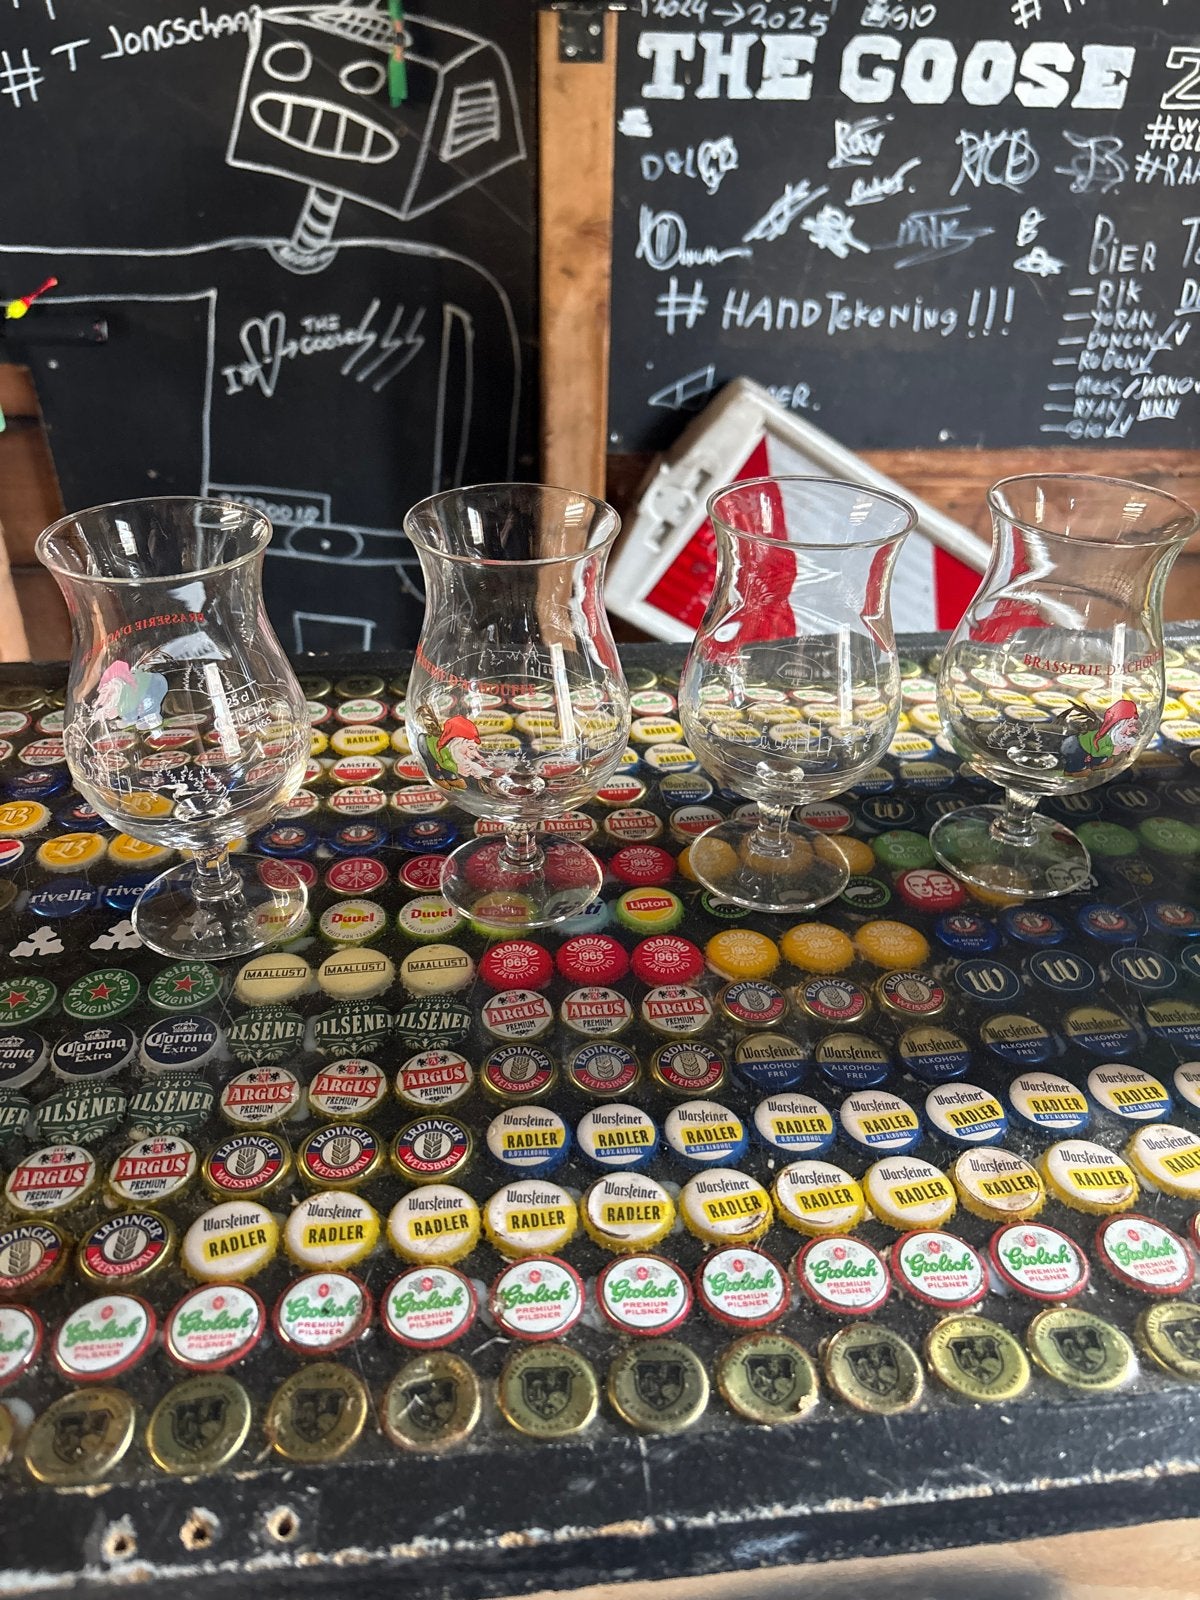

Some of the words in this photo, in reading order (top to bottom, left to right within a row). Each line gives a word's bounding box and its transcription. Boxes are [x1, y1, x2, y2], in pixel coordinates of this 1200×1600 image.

[637, 31, 818, 101] THE
[839, 34, 1136, 109] GOOSE
[1023, 652, 1102, 677] BRASSERIE
[346, 735, 380, 745] RADLER
[336, 794, 382, 805] ARGUS
[608, 818, 656, 829] ARGUS
[630, 858, 653, 868] 1965
[30, 889, 92, 904] rivella
[629, 899, 670, 910] Lipton
[331, 912, 375, 924] Duvel
[410, 907, 453, 919] Duvel
[503, 957, 529, 969] 1965
[155, 963, 215, 987] Heineken
[493, 965, 541, 980] APERITIVO
[69, 971, 132, 998] Heineken
[727, 982, 778, 1000] ERDINGER
[71, 996, 127, 1014] ORIGINAL
[154, 989, 207, 1005] ORIGINAL
[338, 1004, 371, 1015] 1340
[570, 1002, 625, 1019] ARGUS
[583, 1018, 614, 1028] PREMIUM
[987, 1023, 1043, 1040] Warsteiner
[56, 1037, 127, 1058] Corona
[145, 1031, 213, 1049] Corona
[75, 1051, 112, 1063] Extra
[162, 1044, 198, 1055] Extra
[575, 1044, 631, 1067] ERDINGER
[742, 1044, 800, 1060] Warsteiner
[823, 1045, 883, 1061] Warsteiner
[1016, 1048, 1036, 1057] FREI
[406, 1065, 467, 1087] ARGUS
[767, 1070, 788, 1078] FREI
[1096, 1071, 1148, 1084] Warsteiner
[65, 1087, 102, 1098] 1340
[316, 1078, 378, 1095] ARGUS
[420, 1086, 453, 1096] PREMIUM
[1019, 1080, 1071, 1094] Warsteiner
[325, 1096, 360, 1107] PREMIUM
[934, 1090, 985, 1106] Warsteiner
[1112, 1086, 1164, 1105] RADLER
[767, 1100, 818, 1115] Warsteiner
[850, 1098, 901, 1113] Warsteiner
[1032, 1097, 1084, 1113] RADLER
[503, 1114, 554, 1128] Warsteiner
[592, 1113, 642, 1127] Warsteiner
[950, 1104, 1000, 1126] RADLER
[402, 1120, 465, 1142] ERDINGER
[776, 1118, 828, 1134] RADLER
[863, 1114, 914, 1134] RADLER
[310, 1125, 374, 1149] ERDINGER
[507, 1132, 558, 1149] RADLER
[597, 1129, 650, 1147] RADLER
[1142, 1135, 1196, 1151] Warsteiner
[1059, 1149, 1114, 1165] Warsteiner
[118, 1156, 188, 1176] ARGUS
[970, 1158, 1023, 1175] Warsteiner
[129, 1178, 167, 1190] PREMIUM
[696, 1178, 750, 1194] Warsteiner
[789, 1169, 842, 1186] Warsteiner
[983, 1173, 1037, 1197] RADLER
[1074, 1170, 1130, 1187] RADLER
[604, 1181, 658, 1199] Warsteiner
[408, 1195, 464, 1212] Warsteiner
[708, 1195, 763, 1219] RADLER
[800, 1188, 854, 1210] RADLER
[307, 1203, 364, 1219] Warsteiner
[607, 1204, 661, 1222] RADLER
[94, 1214, 163, 1241] ERDINGER
[203, 1212, 261, 1233] Warsteiner
[413, 1213, 469, 1237] RADLER
[308, 1224, 364, 1244] RADLER
[208, 1228, 268, 1258] RADLER
[1109, 1236, 1178, 1266] Grolsch
[905, 1252, 974, 1278] Grolsch
[1001, 1243, 1072, 1271] Grolsch
[808, 1258, 879, 1284] Grolsch
[923, 1273, 968, 1282] PREMIUM
[1023, 1267, 1067, 1276] PREMIUM
[1028, 1274, 1070, 1282] PILSNER
[607, 1276, 679, 1303] Grolsch
[706, 1268, 777, 1296] Grolsch
[927, 1280, 968, 1289] PILSNER
[500, 1278, 572, 1306] Grolsch
[723, 1292, 769, 1301] PREMIUM
[392, 1286, 464, 1319] Grolsch
[727, 1298, 769, 1307] PILSNER
[176, 1306, 252, 1337] Grolsch
[406, 1311, 454, 1322] PREMIUM
[408, 1318, 453, 1330] PILSNER
[64, 1316, 138, 1348] Grolsch
